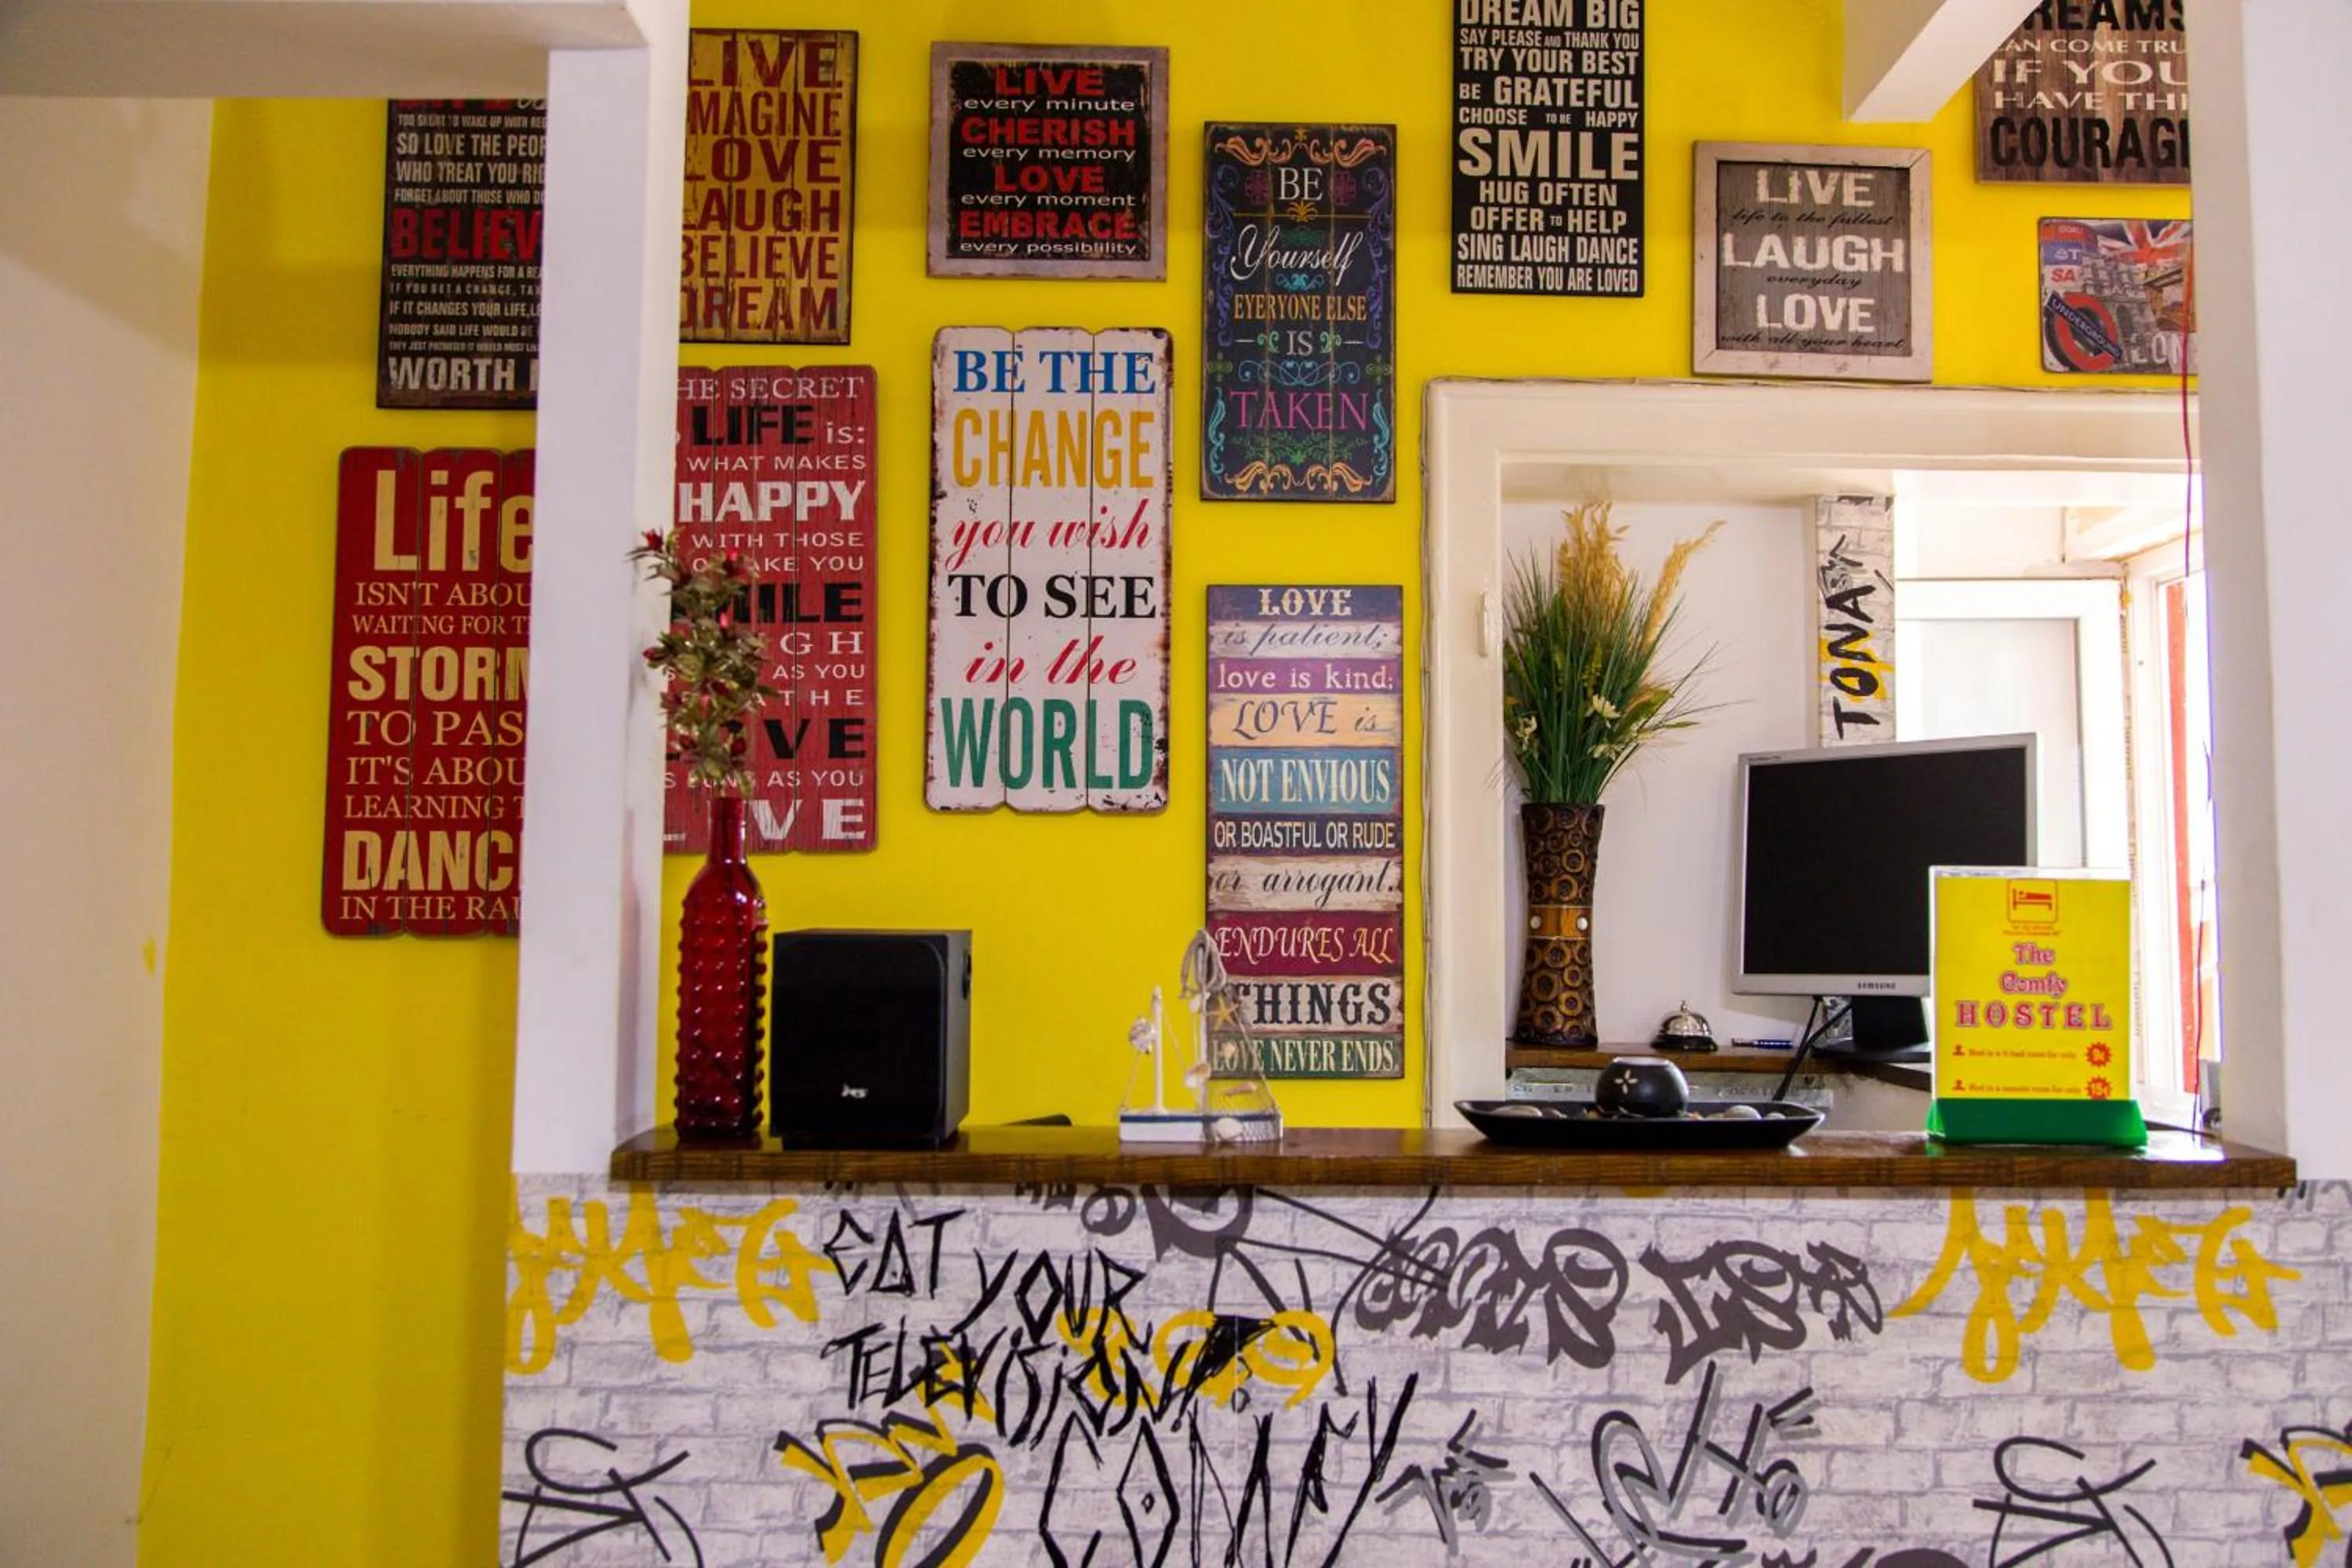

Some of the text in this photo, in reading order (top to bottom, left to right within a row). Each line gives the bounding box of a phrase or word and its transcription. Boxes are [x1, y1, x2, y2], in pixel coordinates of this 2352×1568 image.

[1461, 0, 1639, 29] DREAM BIG
[1461, 28, 1487, 45] SAY
[1492, 29, 1542, 47] PLEASE
[1564, 31, 1609, 49] THANK
[1613, 33, 1639, 50] YOU
[2050, 39, 2129, 53] COME
[1461, 47, 1639, 75] TRY YOUR BEST
[1994, 59, 2188, 85] IF YOU
[995, 67, 1105, 96] LIVE
[1459, 75, 1639, 109] BE GRATEFUL
[964, 98, 1134, 112] every minute
[1994, 91, 2105, 109] HAVE
[961, 117, 1135, 146] CHERISH
[1459, 107, 1638, 129] CHOOSE TO BE HAPPY
[397, 132, 419, 155] SO
[424, 133, 465, 155] LOVE
[471, 134, 501, 155] THE
[964, 148, 1136, 162] every memory
[1458, 128, 1639, 180] SMILE
[396, 161, 517, 183] WHO TREAT YOU
[993, 165, 1104, 193] LOVE
[1278, 168, 1323, 201] BE
[394, 189, 529, 204] FORGET ABOUT THOSE WHO
[961, 194, 1136, 207] every moment
[1479, 180, 1617, 206] HUG OFTEN
[1756, 169, 1875, 207] LIVE
[960, 210, 1141, 239] EMBRACE
[1470, 206, 1627, 234] OFFER TO HELP
[1732, 209, 1893, 228] life to the fullest
[394, 209, 540, 260] BELIEV
[960, 242, 1018, 254] every
[1230, 223, 1363, 286] Yourself
[1458, 234, 1638, 264] SING LAUGH DANCE
[1723, 233, 1904, 272] LAUGH
[392, 265, 515, 278] EVERYTHING HAPPENS FOR
[1457, 264, 1638, 292] REMEMBER YOU ARE LOVED
[1766, 274, 1861, 289] everyday
[416, 302, 500, 318] CHANGES YOUR
[1327, 296, 1367, 321] ELSE
[1757, 293, 1875, 332] LOVE
[433, 324, 517, 336] SAID LIFE WOULD
[1286, 331, 1313, 356] IS
[1721, 332, 1904, 349] with all your heart
[389, 357, 515, 390] WORTH
[953, 350, 1155, 394] BE THE
[731, 377, 864, 399] SECRET
[1229, 390, 1369, 430] TAKEN
[692, 405, 865, 446] LIFE is:
[953, 408, 1154, 488] CHANGE
[687, 456, 866, 470] WHAT MAKES
[678, 480, 866, 523] HAPPY
[374, 470, 534, 572] Life
[692, 534, 763, 548] WITH
[775, 532, 865, 548] THOSE
[945, 499, 1149, 572] you wish
[810, 557, 863, 572] YOU
[356, 582, 438, 606] ISN'T
[948, 574, 1156, 618] TO SEE
[1258, 589, 1352, 616] LOVE
[462, 616, 506, 634] FOR
[1224, 622, 1388, 655] is patient;
[772, 665, 865, 680] AS YOU
[966, 636, 1137, 684] in the
[1218, 663, 1393, 689] love is kind;
[347, 710, 416, 746] TO
[1232, 699, 1394, 740] LOVE is
[941, 697, 1153, 789] WORLD
[346, 756, 525, 785] IT'S ABOU
[768, 771, 800, 787] AS
[812, 770, 863, 786] YOU
[1220, 757, 1390, 803] NOT ENVIOUS
[344, 795, 504, 819] LEARNING
[1215, 821, 1396, 849] OR BOASTFUL OR RUDE
[343, 830, 513, 891] DANC
[1215, 860, 1394, 908] or arrogant.
[339, 896, 455, 920] IN THE
[1215, 927, 1393, 964] ENDURES ALL
[2013, 942, 2055, 964] The
[2001, 971, 2067, 998] Comfy
[1956, 1000, 2112, 1030] HOSTEL
[1269, 1040, 1399, 1073] NEVER ENDS.
[823, 1208, 966, 1299] EAT
[950, 1247, 1152, 1355] YOUR
